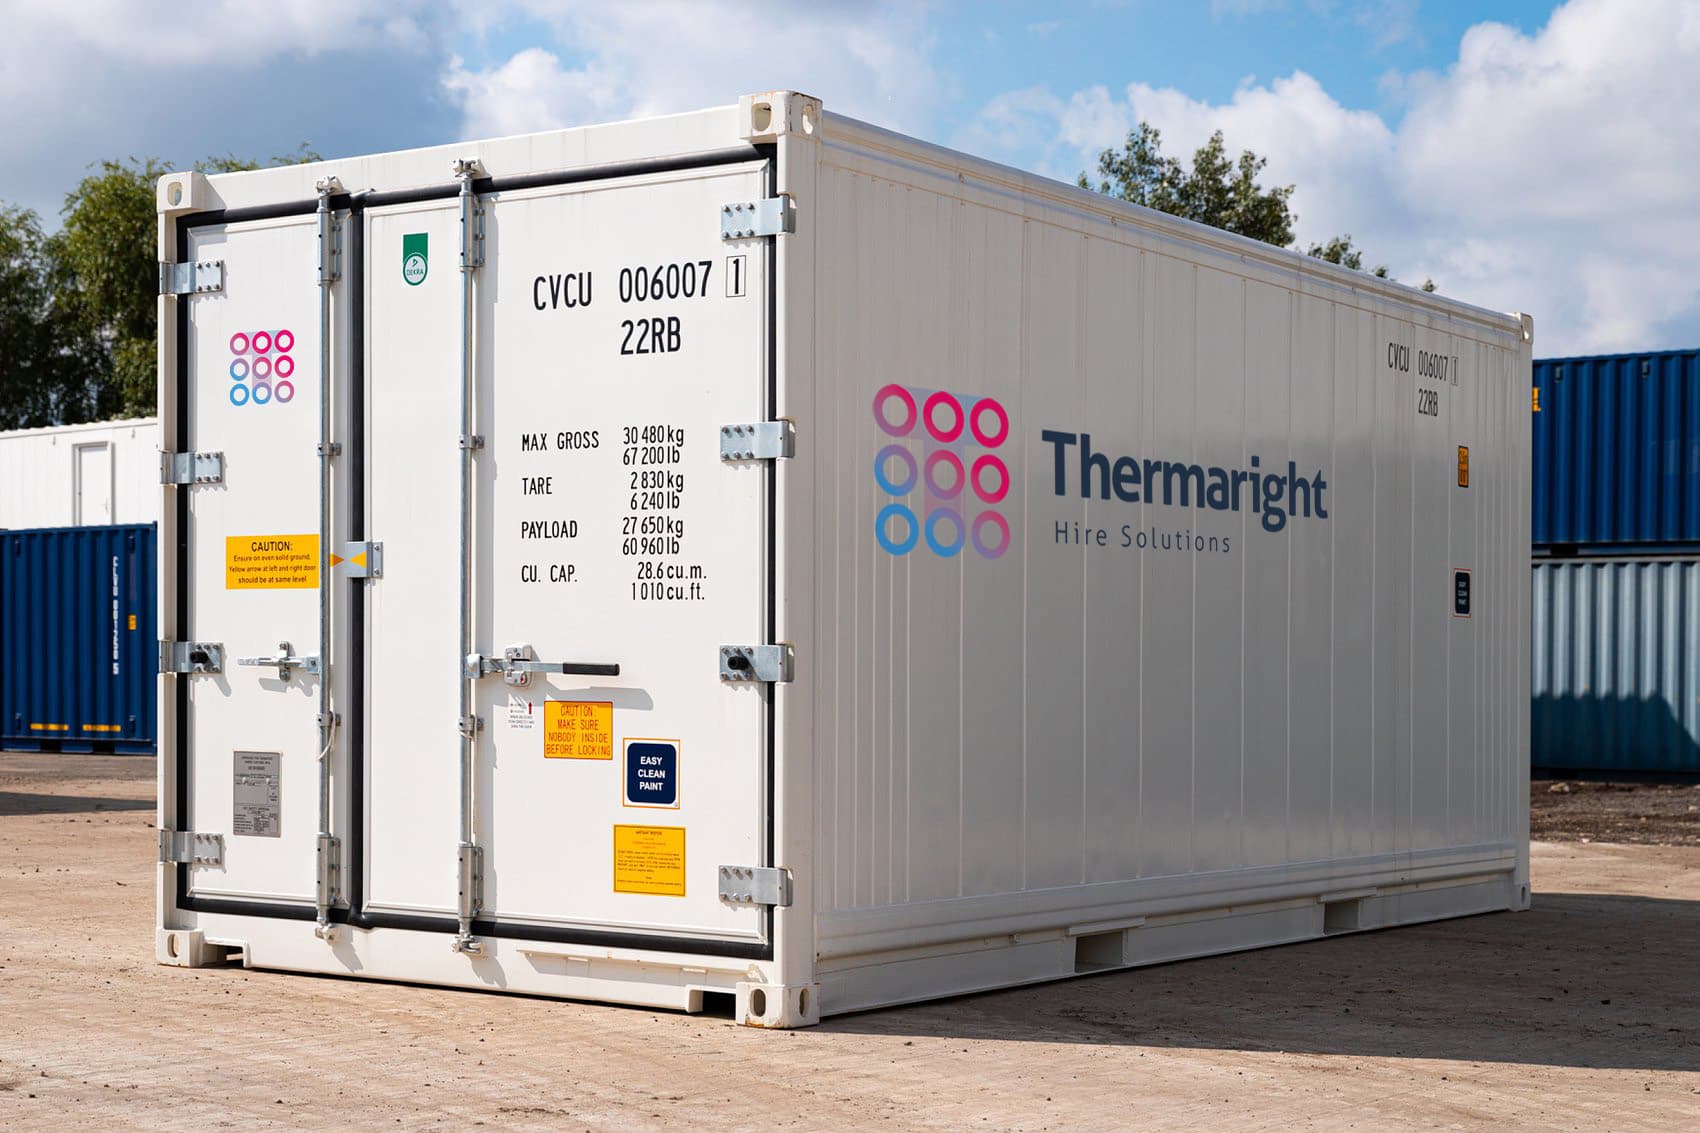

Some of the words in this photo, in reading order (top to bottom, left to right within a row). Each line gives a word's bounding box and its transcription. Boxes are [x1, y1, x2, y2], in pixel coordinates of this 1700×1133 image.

[533, 271, 592, 311] CVCU
[618, 260, 713, 303] 006007
[620, 316, 681, 355] 22RB
[1388, 342, 1409, 373] CVCU
[1418, 350, 1448, 382] 006007
[1418, 388, 1438, 416] 22RB
[522, 433, 548, 452] MAX
[557, 430, 600, 450] GROSS
[522, 477, 552, 495] TARE
[1041, 429, 1329, 533] Thermaright
[521, 520, 578, 539] PAYLOAD
[1055, 520, 1108, 547] Hire
[1120, 525, 1231, 554] Solutions
[251, 540, 293, 552] CAUTION:
[233, 554, 252, 562] Ensure
[275, 553, 289, 561] solid
[229, 565, 246, 573] Yellow
[268, 564, 278, 572] left
[278, 564, 289, 572] and
[290, 563, 303, 573] right
[303, 563, 316, 571] door
[521, 565, 541, 583] CU.
[550, 564, 578, 583] CAP.
[238, 575, 259, 584] should
[259, 575, 267, 583] be
[268, 575, 275, 583] at
[275, 575, 291, 583] same
[292, 574, 307, 583] level
[557, 718, 576, 730] MAKE
[580, 719, 600, 731] SURE
[548, 732, 577, 743] NOBODY
[581, 733, 609, 745] INSIDE
[545, 743, 574, 755] BEFORE
[577, 744, 611, 756] LOCKING
[640, 756, 663, 766] EASY
[637, 768, 666, 779] CLEAN
[639, 781, 664, 791] PAINT
